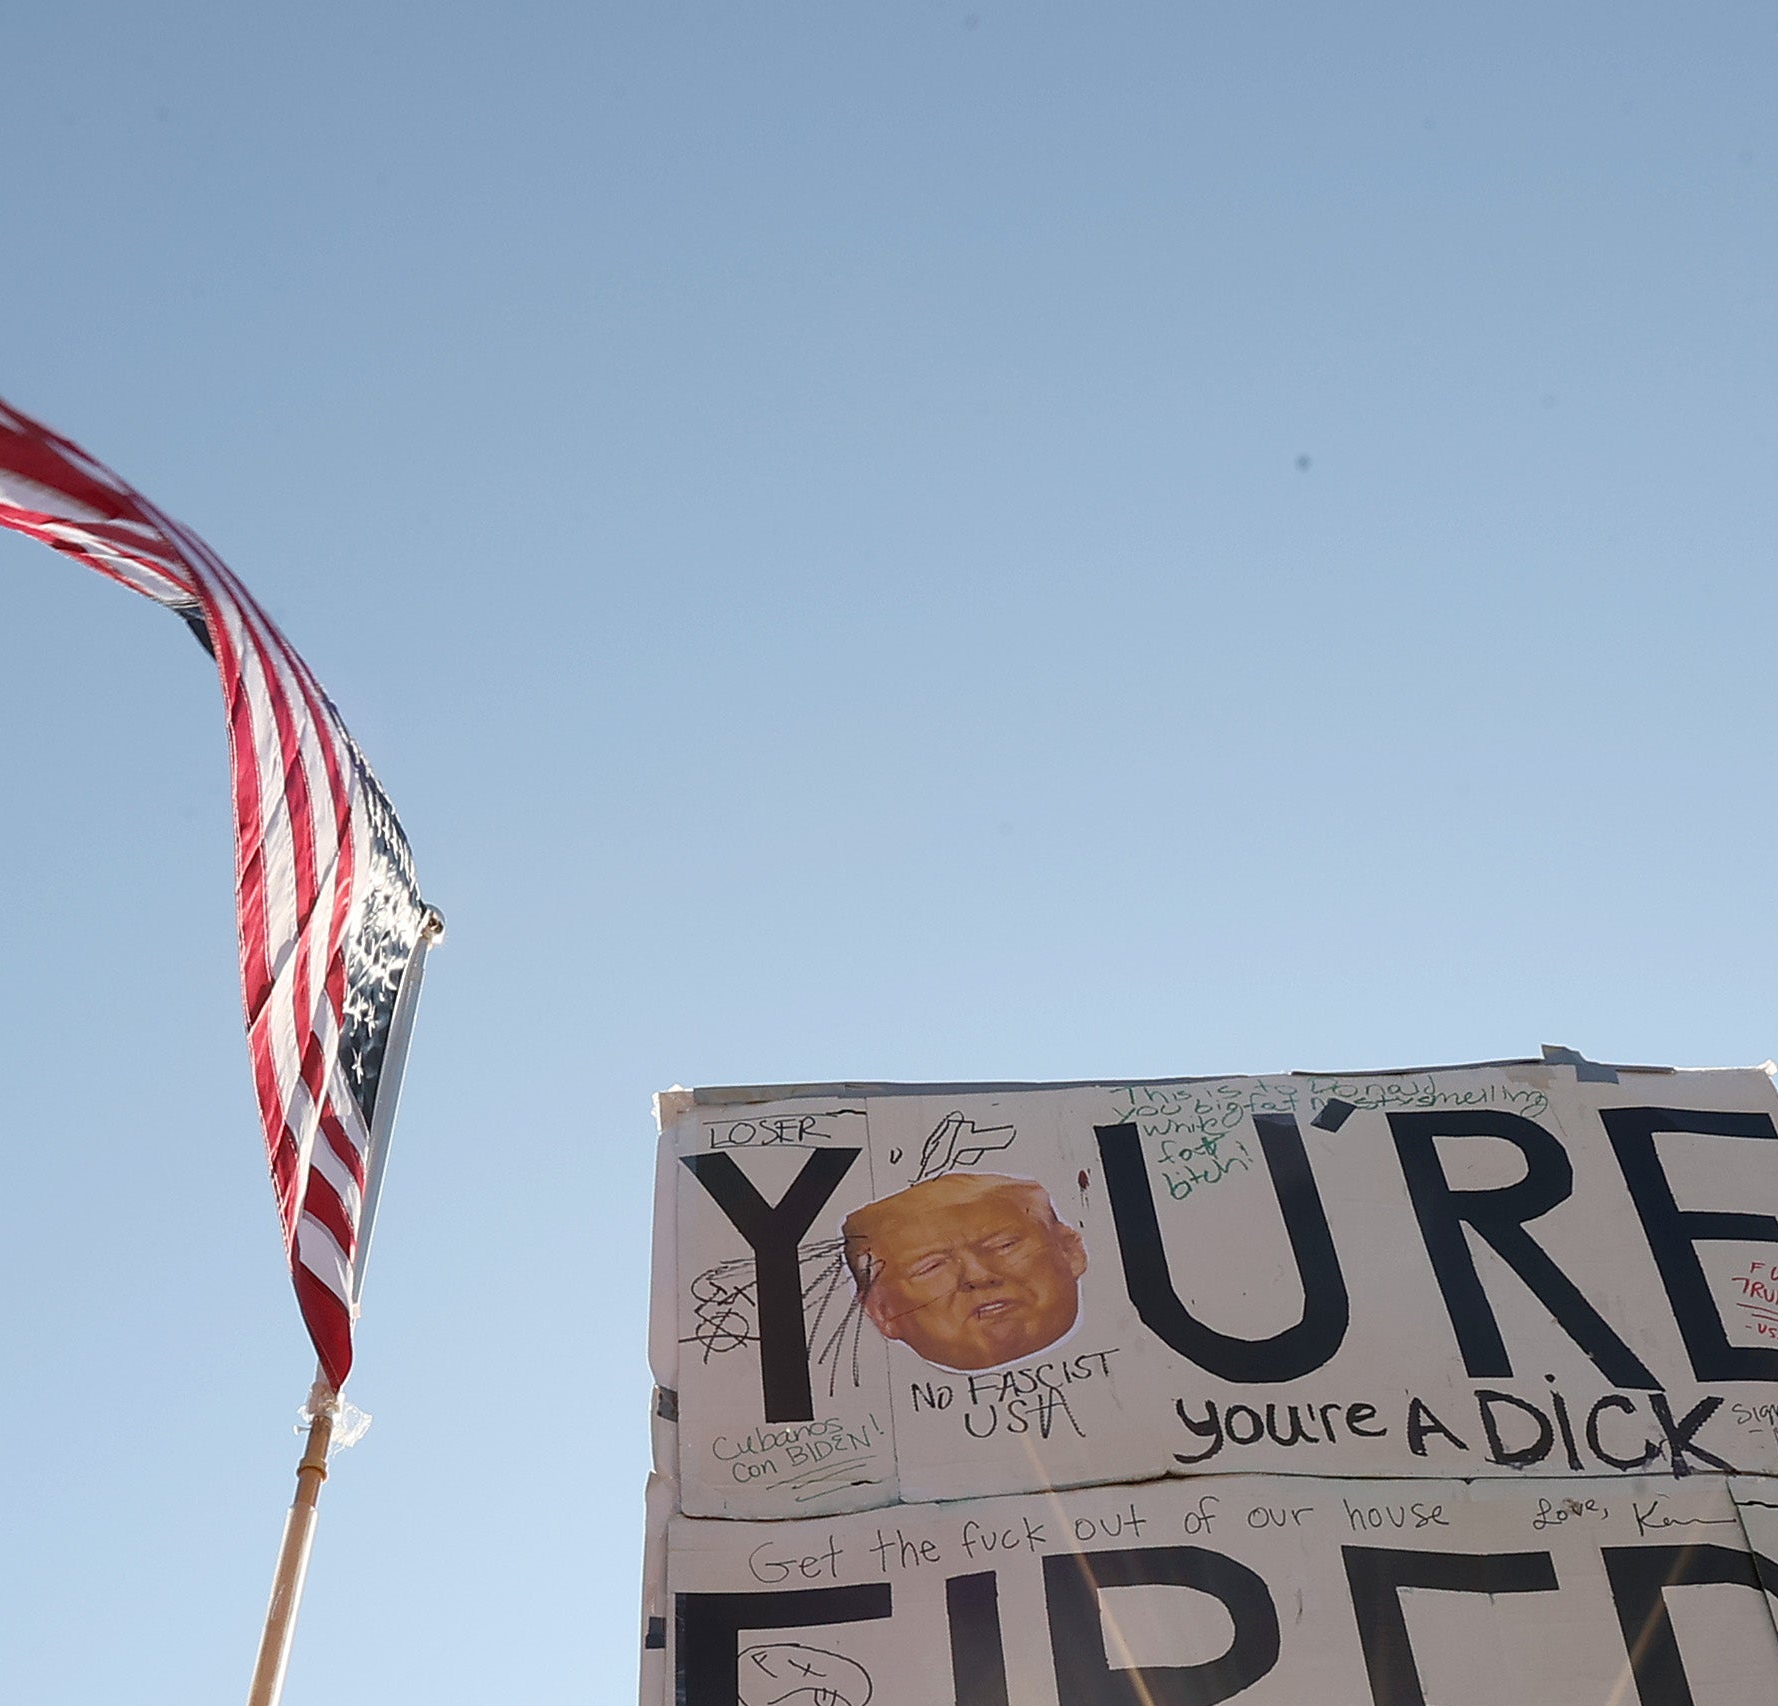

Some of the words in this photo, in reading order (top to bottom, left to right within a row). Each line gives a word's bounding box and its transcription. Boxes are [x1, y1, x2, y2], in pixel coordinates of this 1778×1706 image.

[709, 1113, 831, 1147] LOSER
[911, 1382, 953, 1413] NO
[967, 1349, 1120, 1407] FASCIST
[712, 1418, 843, 1461] Cubanos
[964, 1385, 1086, 1440] USA
[1173, 1397, 1388, 1463] you're
[1406, 1394, 1469, 1456] A
[749, 1541, 843, 1583] Get
[870, 1529, 941, 1572] the
[962, 1517, 1047, 1559] fuck
[1074, 1504, 1147, 1541] out
[1184, 1496, 1220, 1534] of
[1247, 1507, 1317, 1528] our
[1343, 1499, 1451, 1531] house
